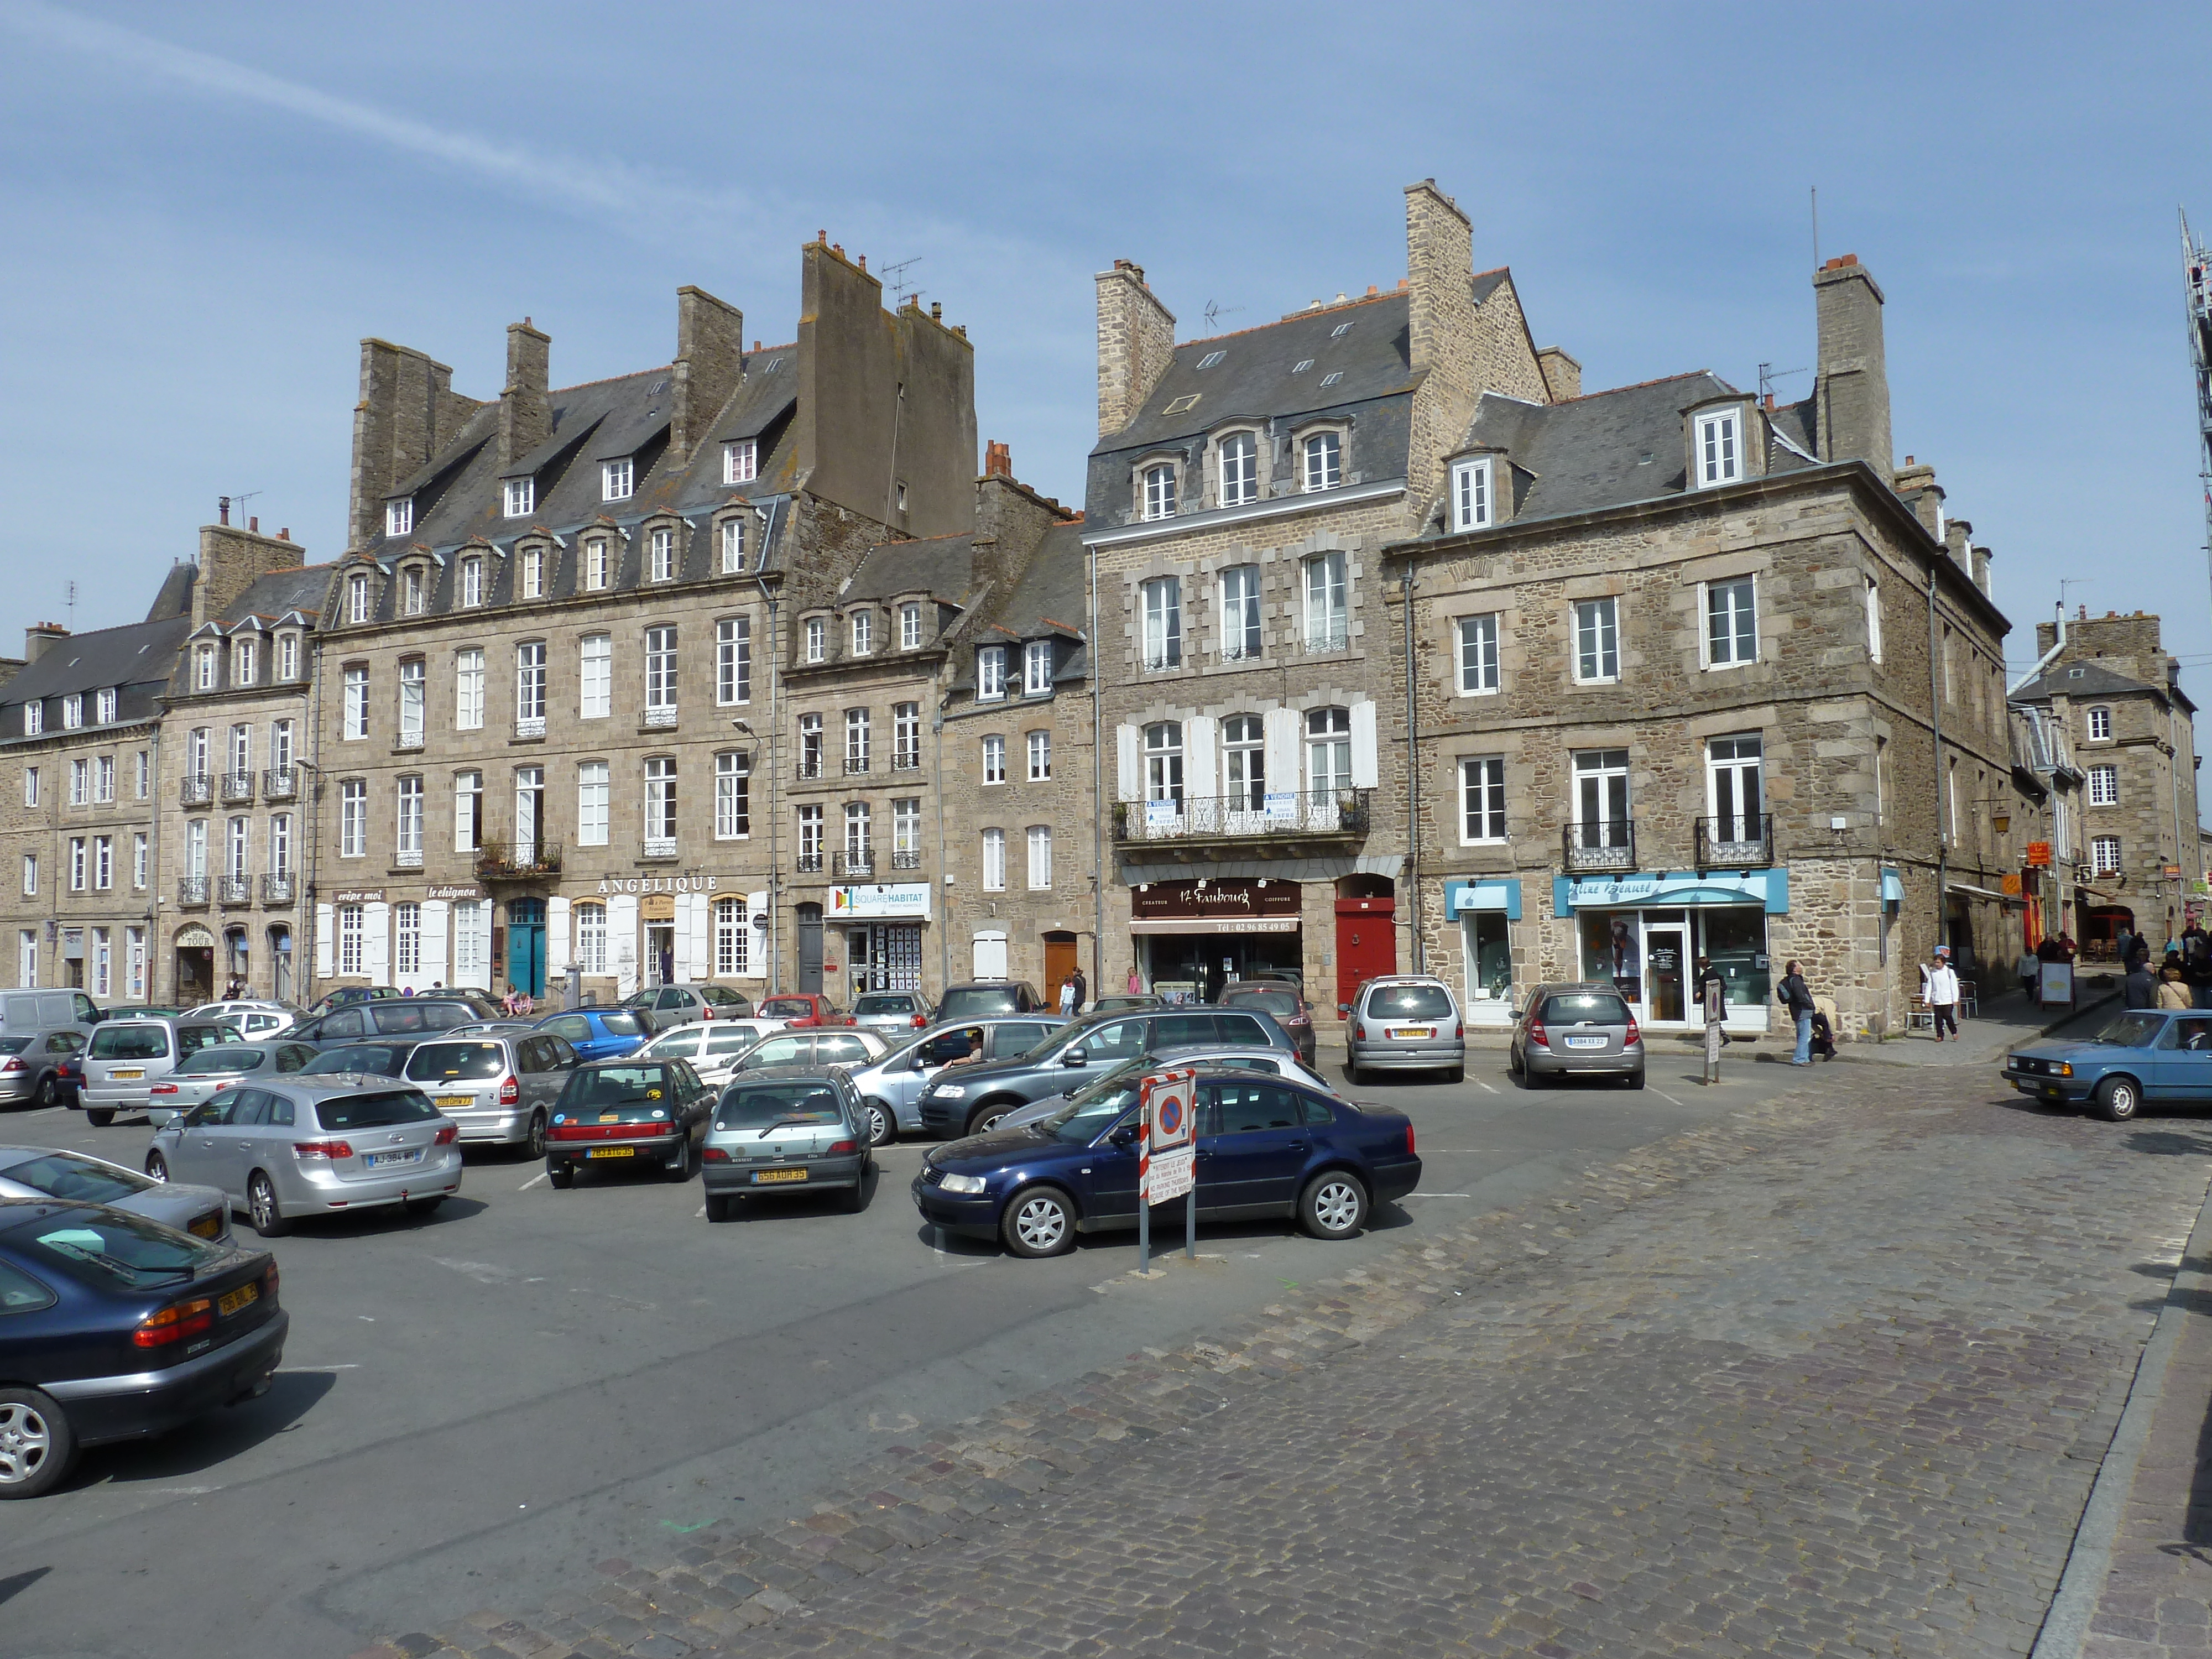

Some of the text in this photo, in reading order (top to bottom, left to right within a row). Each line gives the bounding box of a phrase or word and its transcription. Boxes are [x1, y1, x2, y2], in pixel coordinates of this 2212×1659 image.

[597, 876, 718, 894] ANGELIQUE
[364, 890, 383, 900] moi
[428, 886, 436, 898] le
[1193, 886, 1250, 911] Faubourg
[1217, 924, 1228, 932] Tél
[187, 937, 210, 946] TOUR
[462, 1096, 472, 1104] 77
[592, 1148, 606, 1157] 783
[623, 1146, 633, 1155] 35
[758, 1171, 775, 1181] 656
[794, 1169, 805, 1178] 35
[1156, 1182, 1170, 1190] PARKING
[1150, 1192, 1164, 1200] BECAUSE
